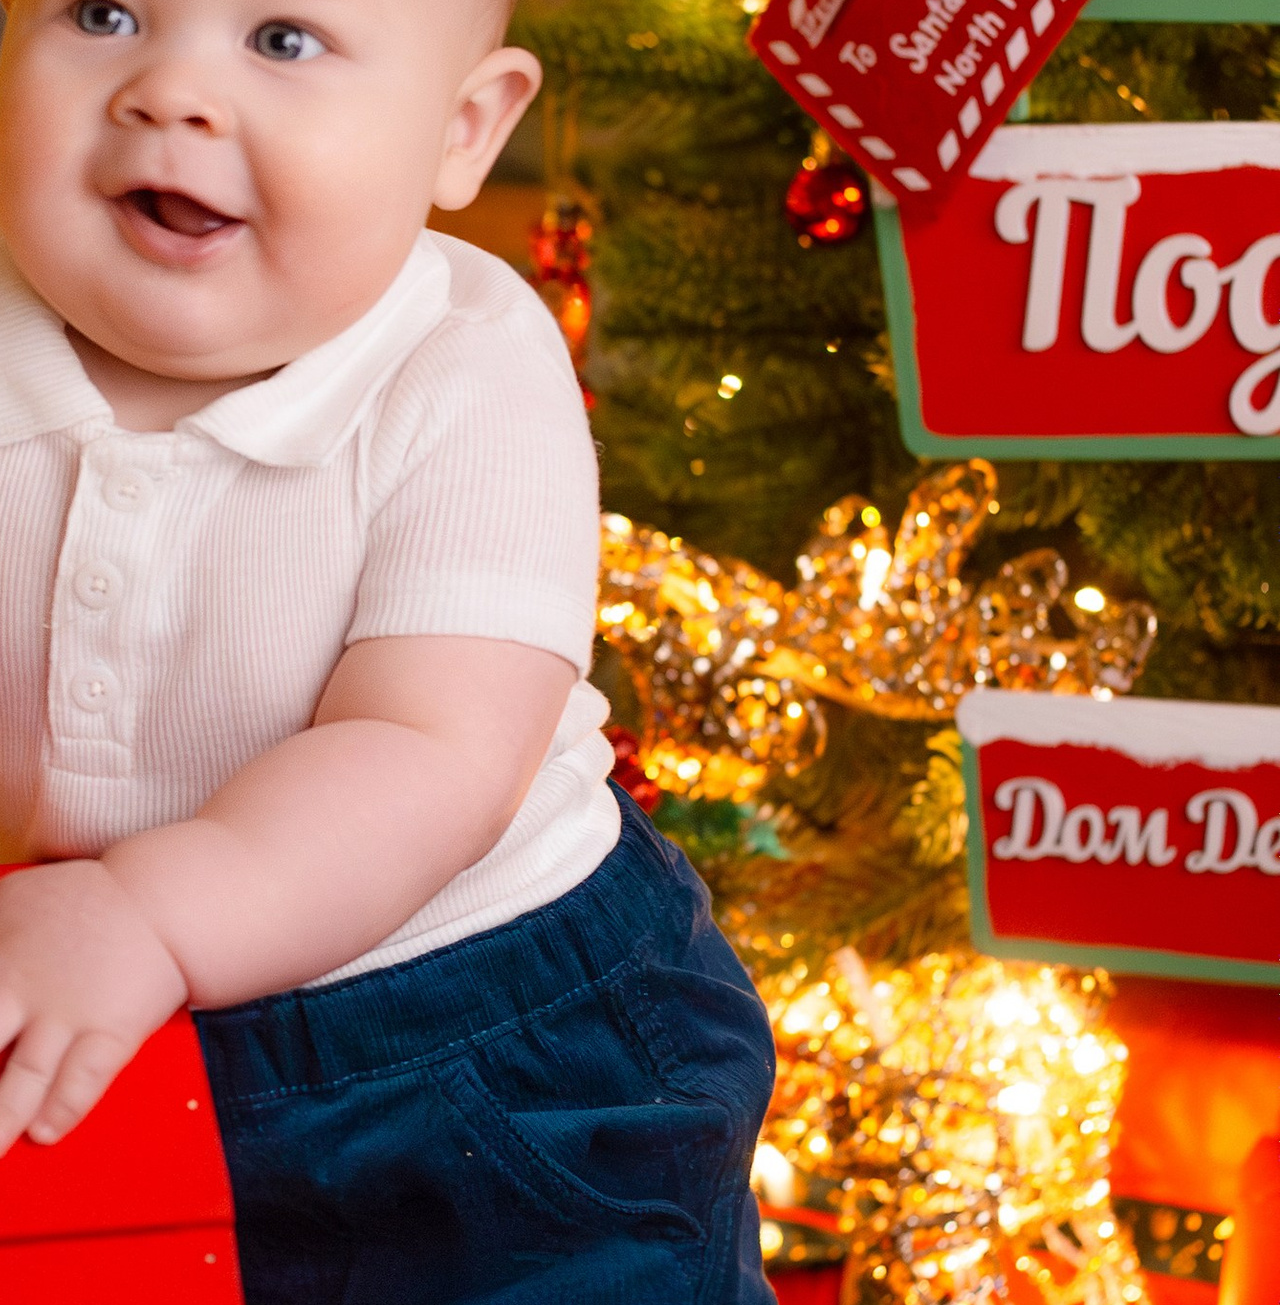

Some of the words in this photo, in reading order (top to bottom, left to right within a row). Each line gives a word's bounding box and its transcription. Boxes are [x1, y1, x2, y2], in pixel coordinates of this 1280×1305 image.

[838, 40, 878, 75] To
[933, 10, 1007, 97] North
[992, 775, 1178, 867] Дом
